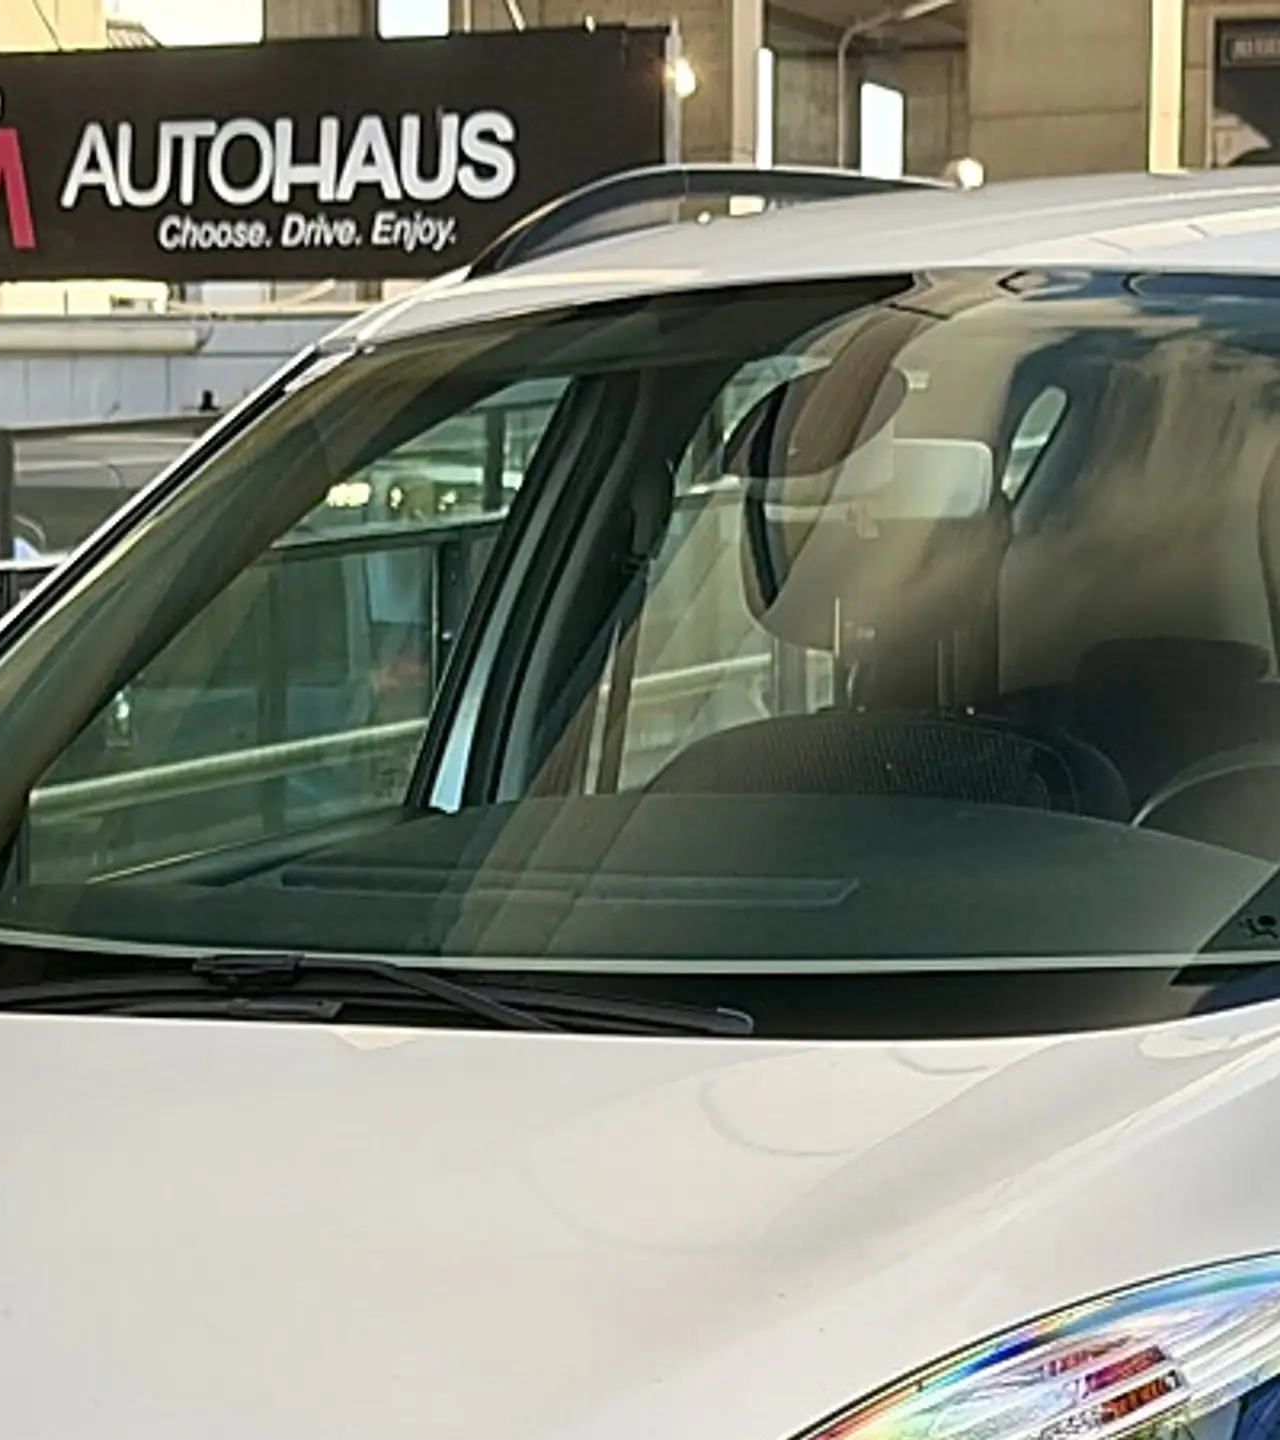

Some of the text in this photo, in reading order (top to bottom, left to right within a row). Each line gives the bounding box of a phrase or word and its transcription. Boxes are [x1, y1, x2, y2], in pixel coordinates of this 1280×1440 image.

[61, 109, 517, 208] AUTOHAUS
[158, 210, 457, 251] Choose. Drive. Enjoy.
